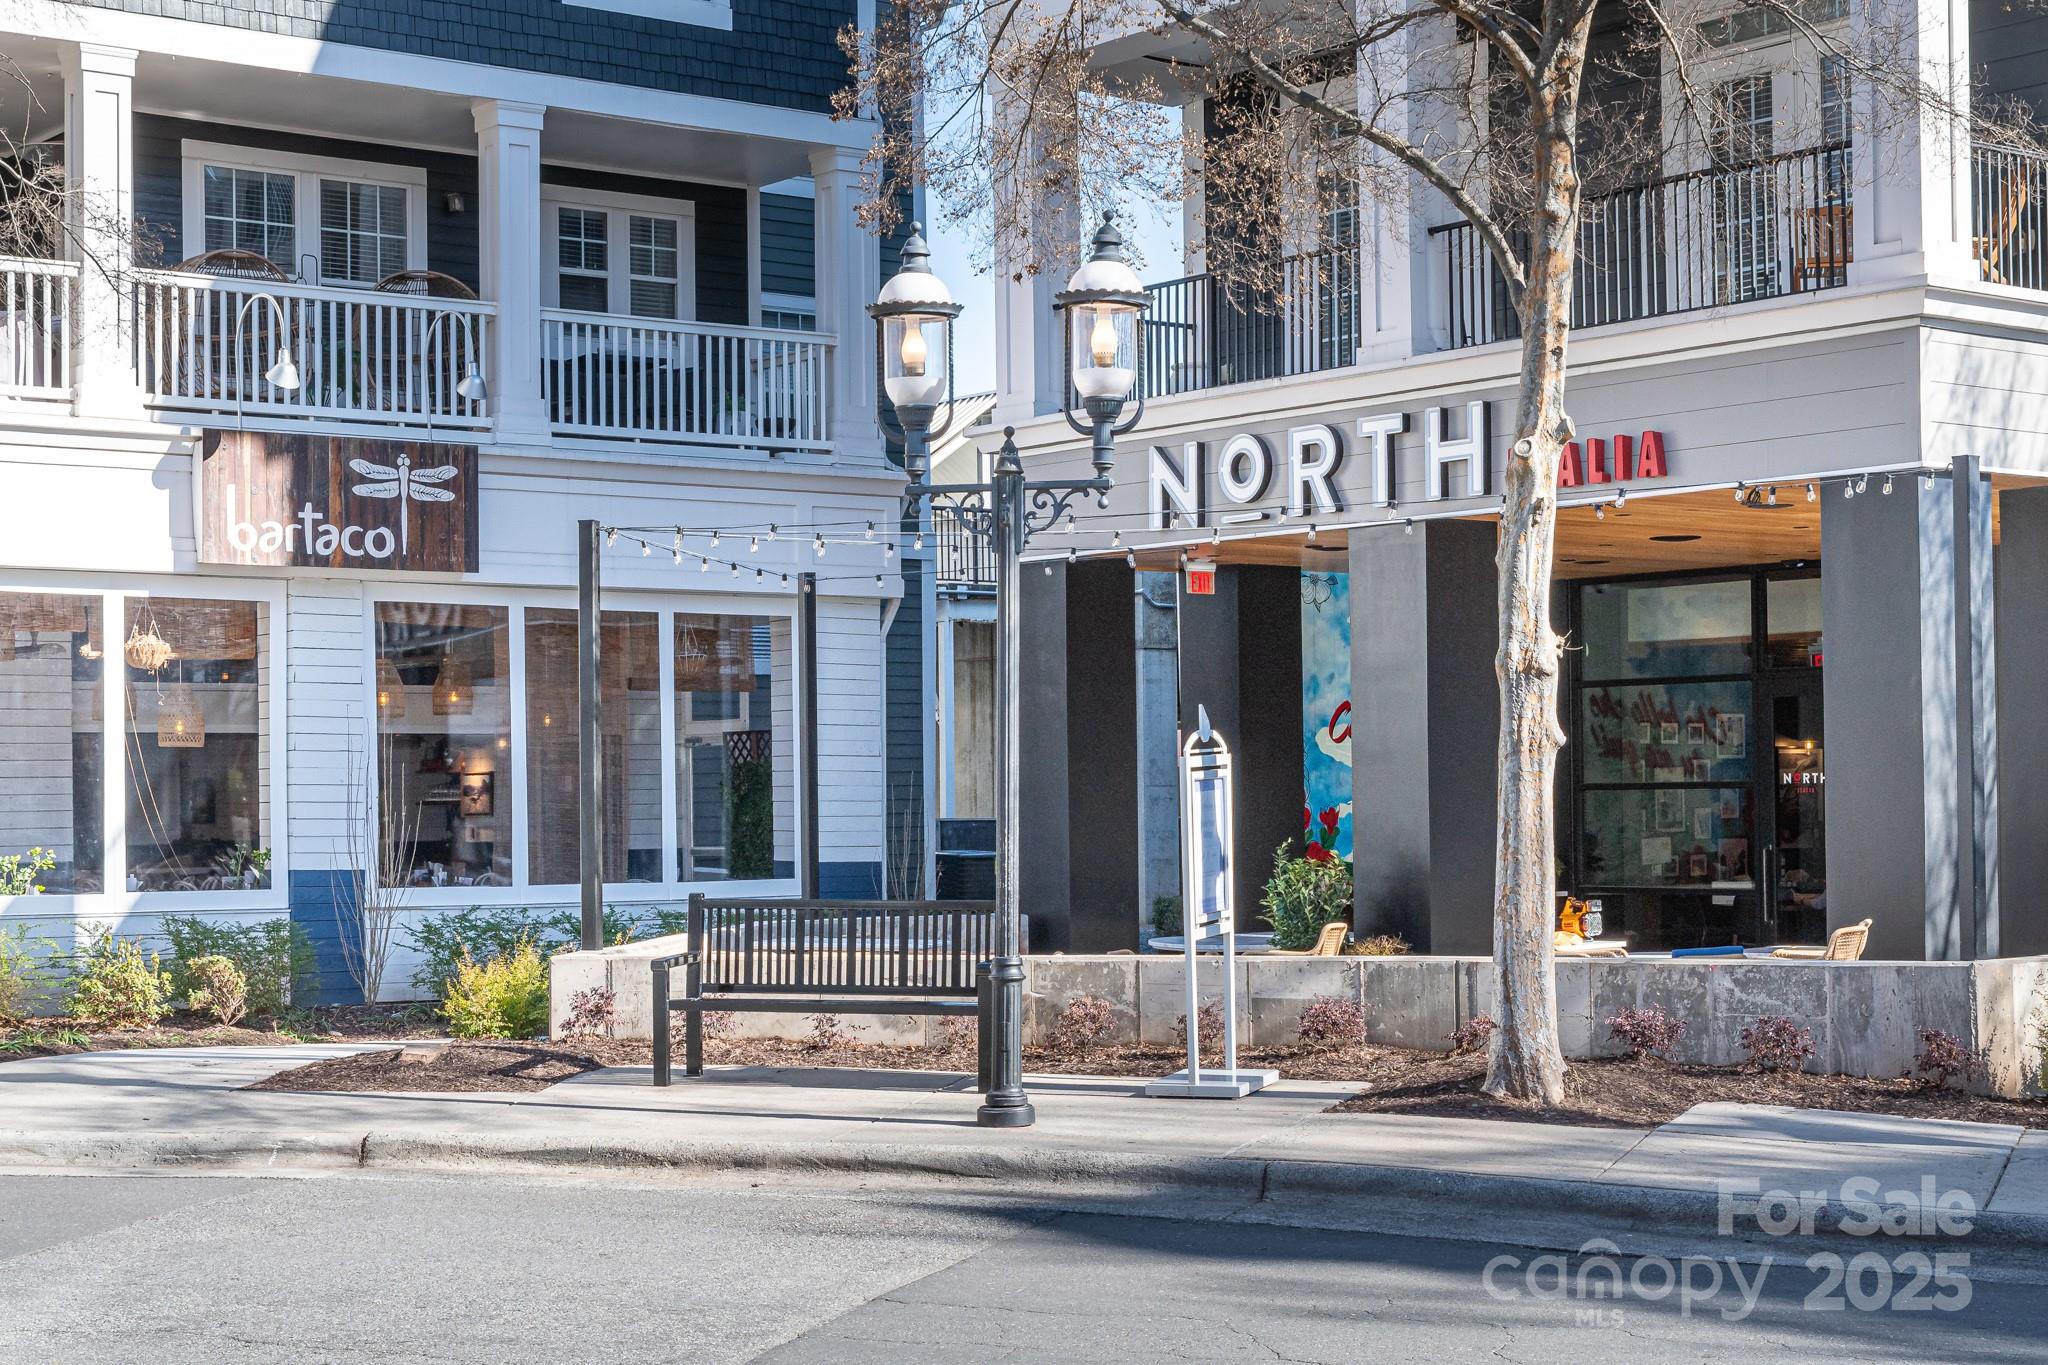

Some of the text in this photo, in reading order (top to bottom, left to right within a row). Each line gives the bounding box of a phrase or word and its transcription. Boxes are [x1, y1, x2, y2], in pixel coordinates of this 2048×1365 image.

[1148, 400, 1668, 530] NORTH ALIA
[226, 484, 396, 559] bartaco
[1191, 571, 1212, 593] EXIT
